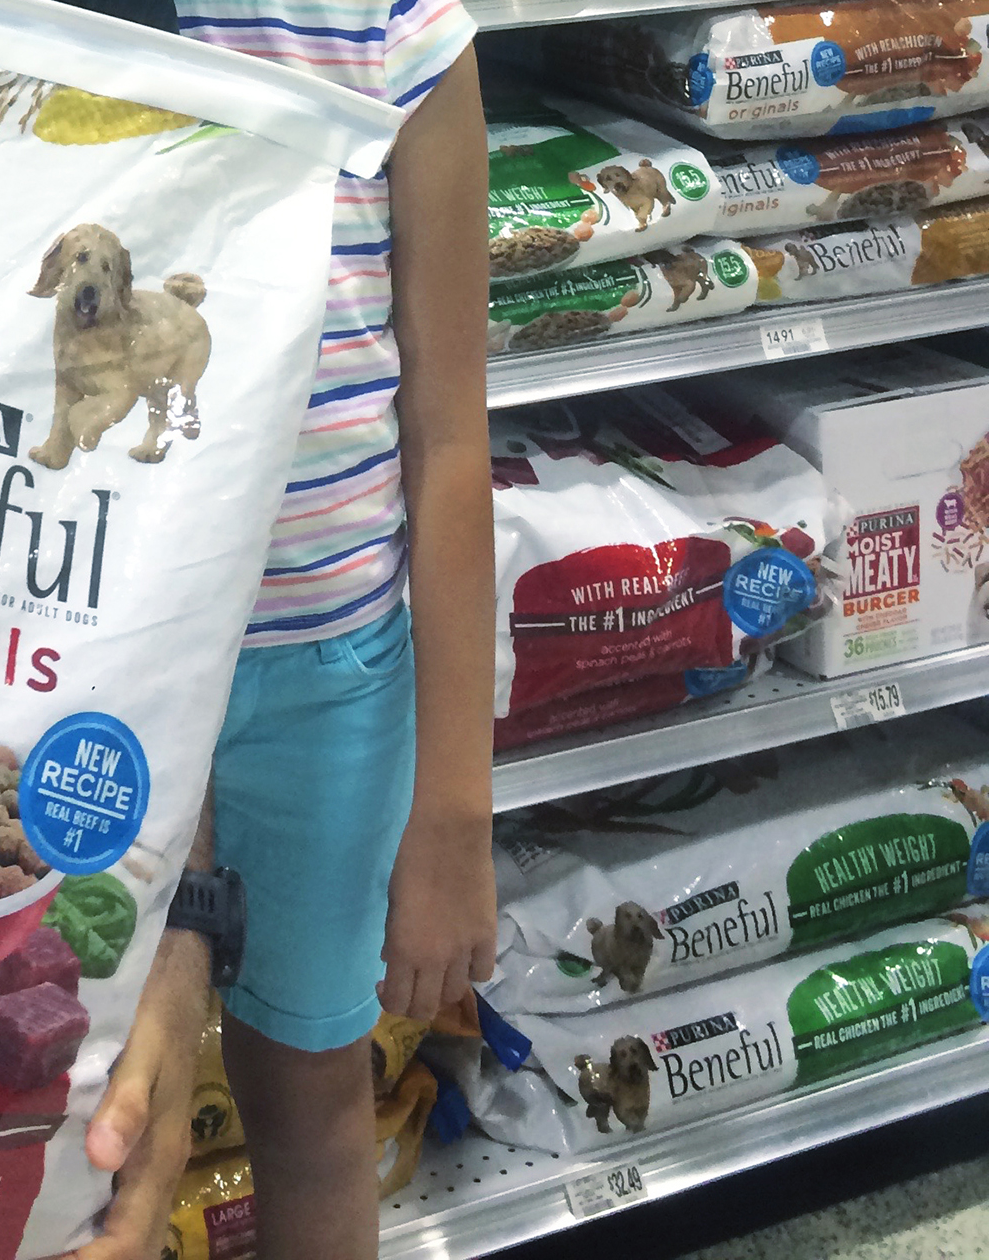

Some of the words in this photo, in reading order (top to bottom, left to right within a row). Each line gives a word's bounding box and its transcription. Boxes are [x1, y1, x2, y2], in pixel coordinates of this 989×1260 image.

[727, 59, 810, 101] Beneful
[816, 226, 907, 274] Beneful
[860, 513, 914, 534] PURINA
[848, 532, 902, 556] MOIST
[735, 574, 802, 598] RECIPE
[757, 561, 793, 584] NEW
[845, 545, 917, 596] MEATY
[571, 580, 615, 605] WITH
[621, 576, 659, 597] REAL
[843, 588, 920, 617] BURGER
[20, 598, 60, 620] ADULT
[66, 609, 99, 627] DOGS
[569, 615, 597, 632] THE
[603, 607, 625, 633] #1
[844, 638, 865, 658] 36
[869, 684, 900, 712] $15.79
[74, 738, 121, 778] NEW
[40, 759, 133, 811] RECIPE
[44, 801, 71, 823] REAL
[72, 809, 97, 831] BEEF
[99, 818, 111, 835] IS
[63, 827, 84, 853] #1
[814, 853, 878, 894] HEALTHY
[880, 833, 936, 864] WEIGHT
[668, 882, 739, 922] PURINA
[664, 891, 779, 962] Beneful
[815, 980, 883, 1022] HEALTHY
[884, 956, 943, 997] WEIGHT
[669, 1013, 736, 1045] PURINA
[813, 1034, 837, 1050] REAL
[839, 1019, 879, 1043] CHICKEN
[880, 1013, 898, 1029] THE
[900, 998, 918, 1024] #1
[919, 984, 966, 1014] INGREDIENT
[662, 1021, 783, 1099] Beneful
[211, 1201, 251, 1227] LARGE
